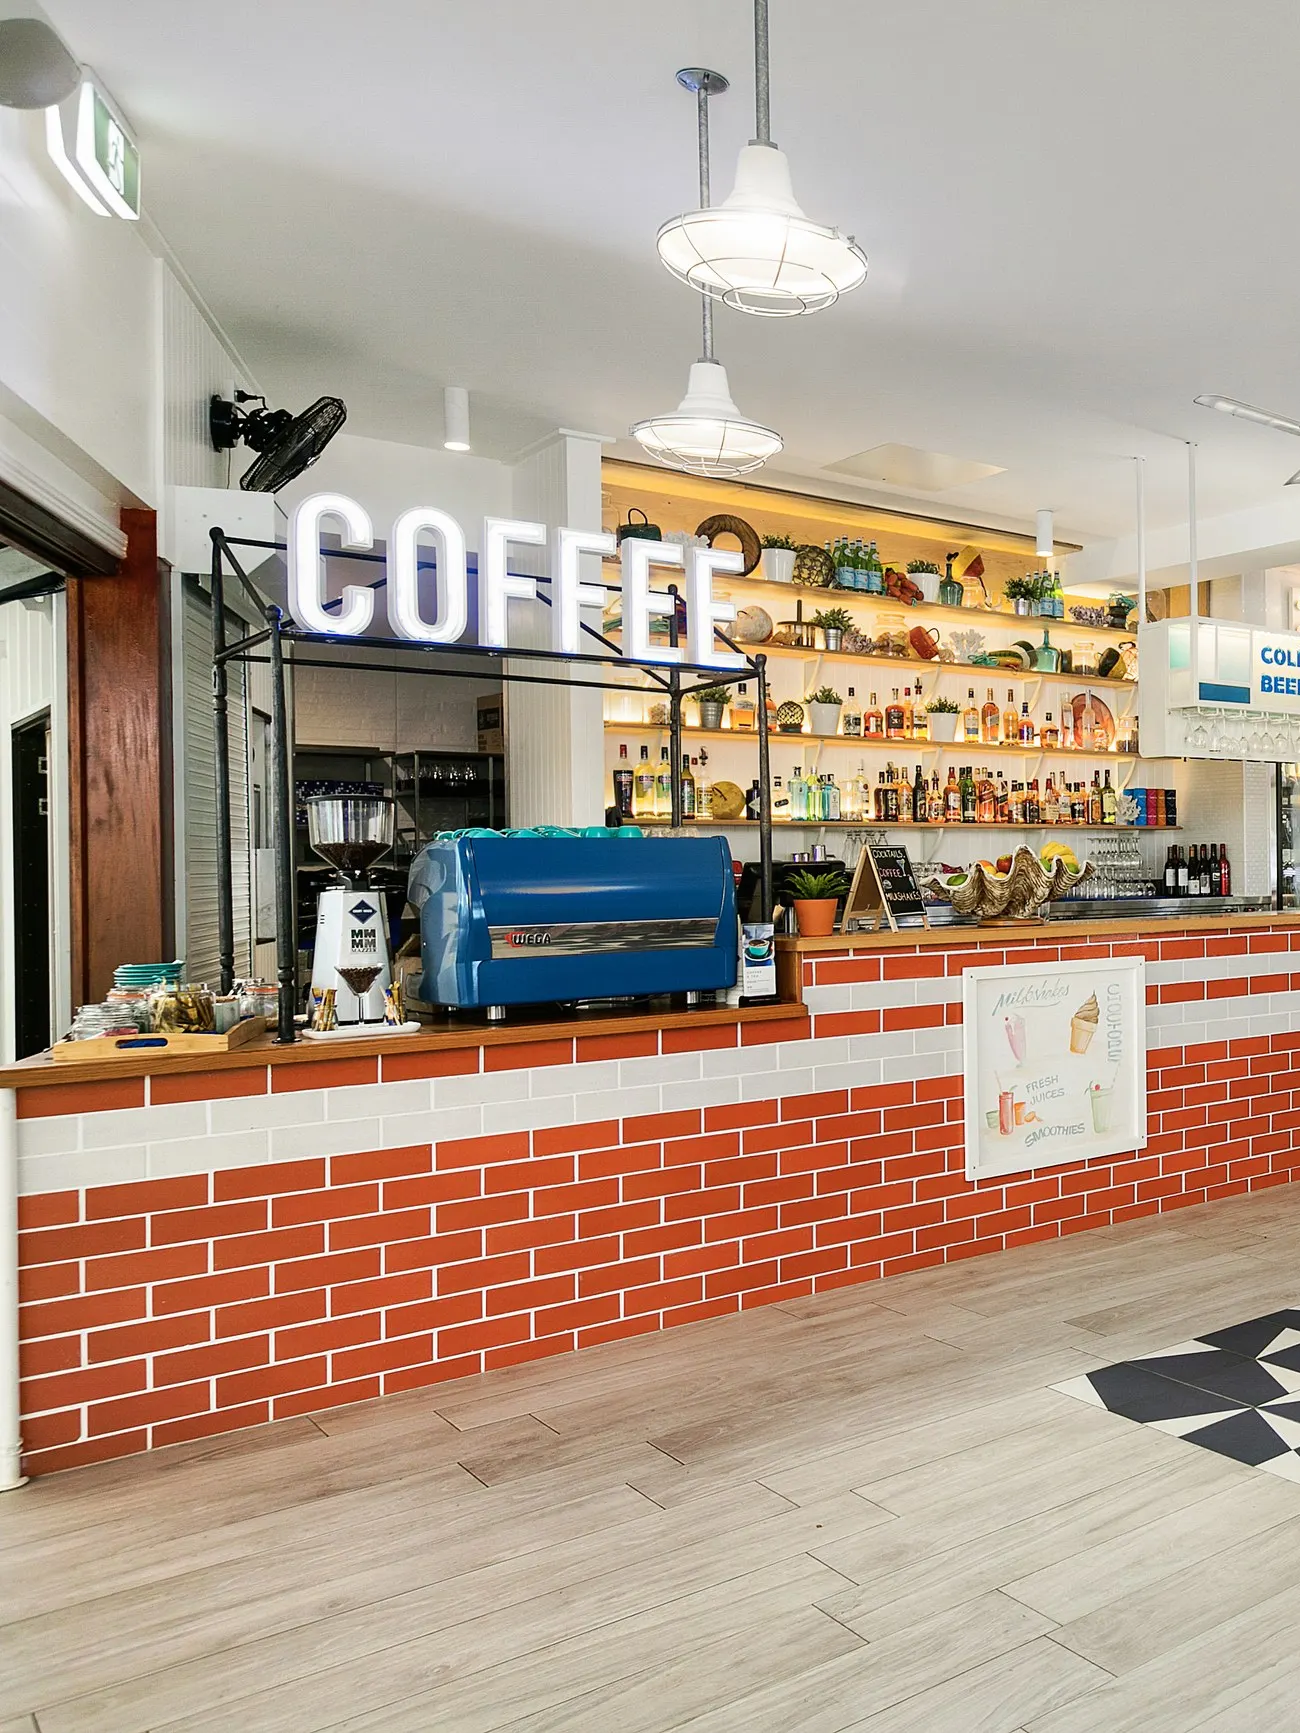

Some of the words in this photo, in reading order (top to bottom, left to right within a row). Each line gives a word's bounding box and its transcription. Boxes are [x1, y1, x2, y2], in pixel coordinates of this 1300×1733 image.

[287, 491, 747, 670] COFFEE
[878, 867, 903, 878] COFFEE
[512, 933, 551, 945] WEGA
[1025, 1075, 1059, 1094] FRESH
[1030, 1088, 1065, 1105] JUICES
[1024, 1122, 1085, 1147] SMOOTHIES
